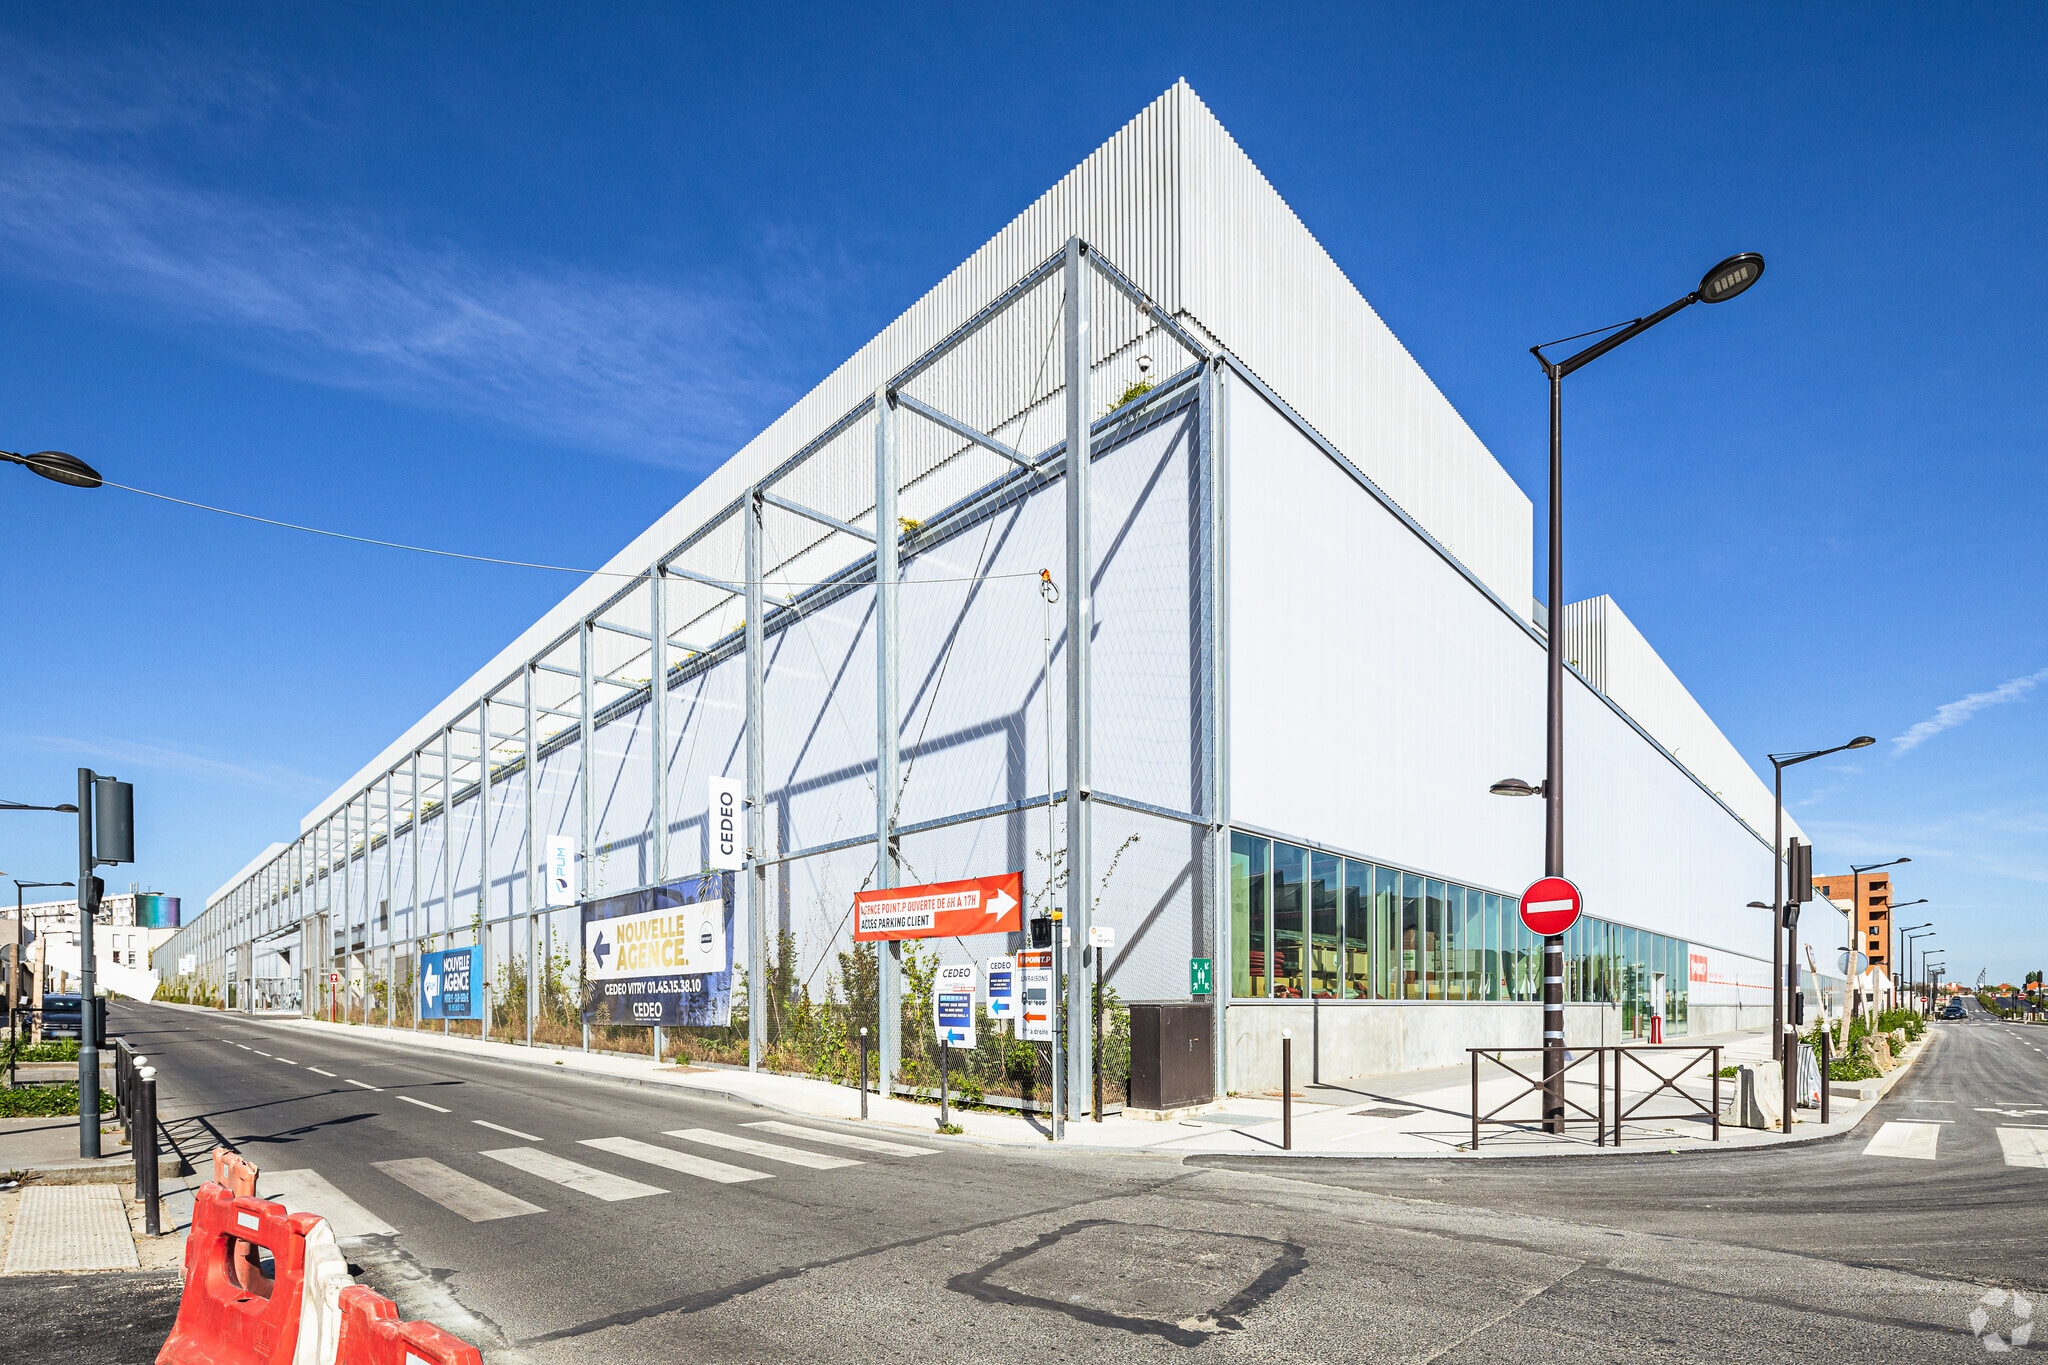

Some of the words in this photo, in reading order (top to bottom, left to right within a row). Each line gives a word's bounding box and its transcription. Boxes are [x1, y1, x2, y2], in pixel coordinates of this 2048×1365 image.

[720, 792, 733, 855] CEDEO
[556, 848, 566, 876] PUM
[861, 903, 880, 915] AGENCE
[882, 902, 907, 914] POINT.P
[907, 899, 935, 912] OUVERTE
[937, 898, 945, 909] DE
[947, 896, 955, 908] 6H
[964, 894, 976, 906] 17H
[616, 914, 684, 944] NOUVELLE
[878, 917, 905, 929] PARKING
[907, 915, 929, 927] CLIENT
[616, 938, 689, 971] AGENCE.
[1025, 956, 1051, 964] POINT.P
[443, 955, 470, 973] NOUVELLE
[990, 962, 1011, 970] CEDEO
[443, 971, 469, 992] AGENCE
[942, 968, 971, 978] CEDEO
[604, 983, 627, 996] CEDEO
[628, 981, 646, 995] VITRY
[647, 979, 701, 994] 01.45.15.38.10
[633, 1001, 663, 1018] CEDEO
[1034, 1028, 1049, 1036] droite
